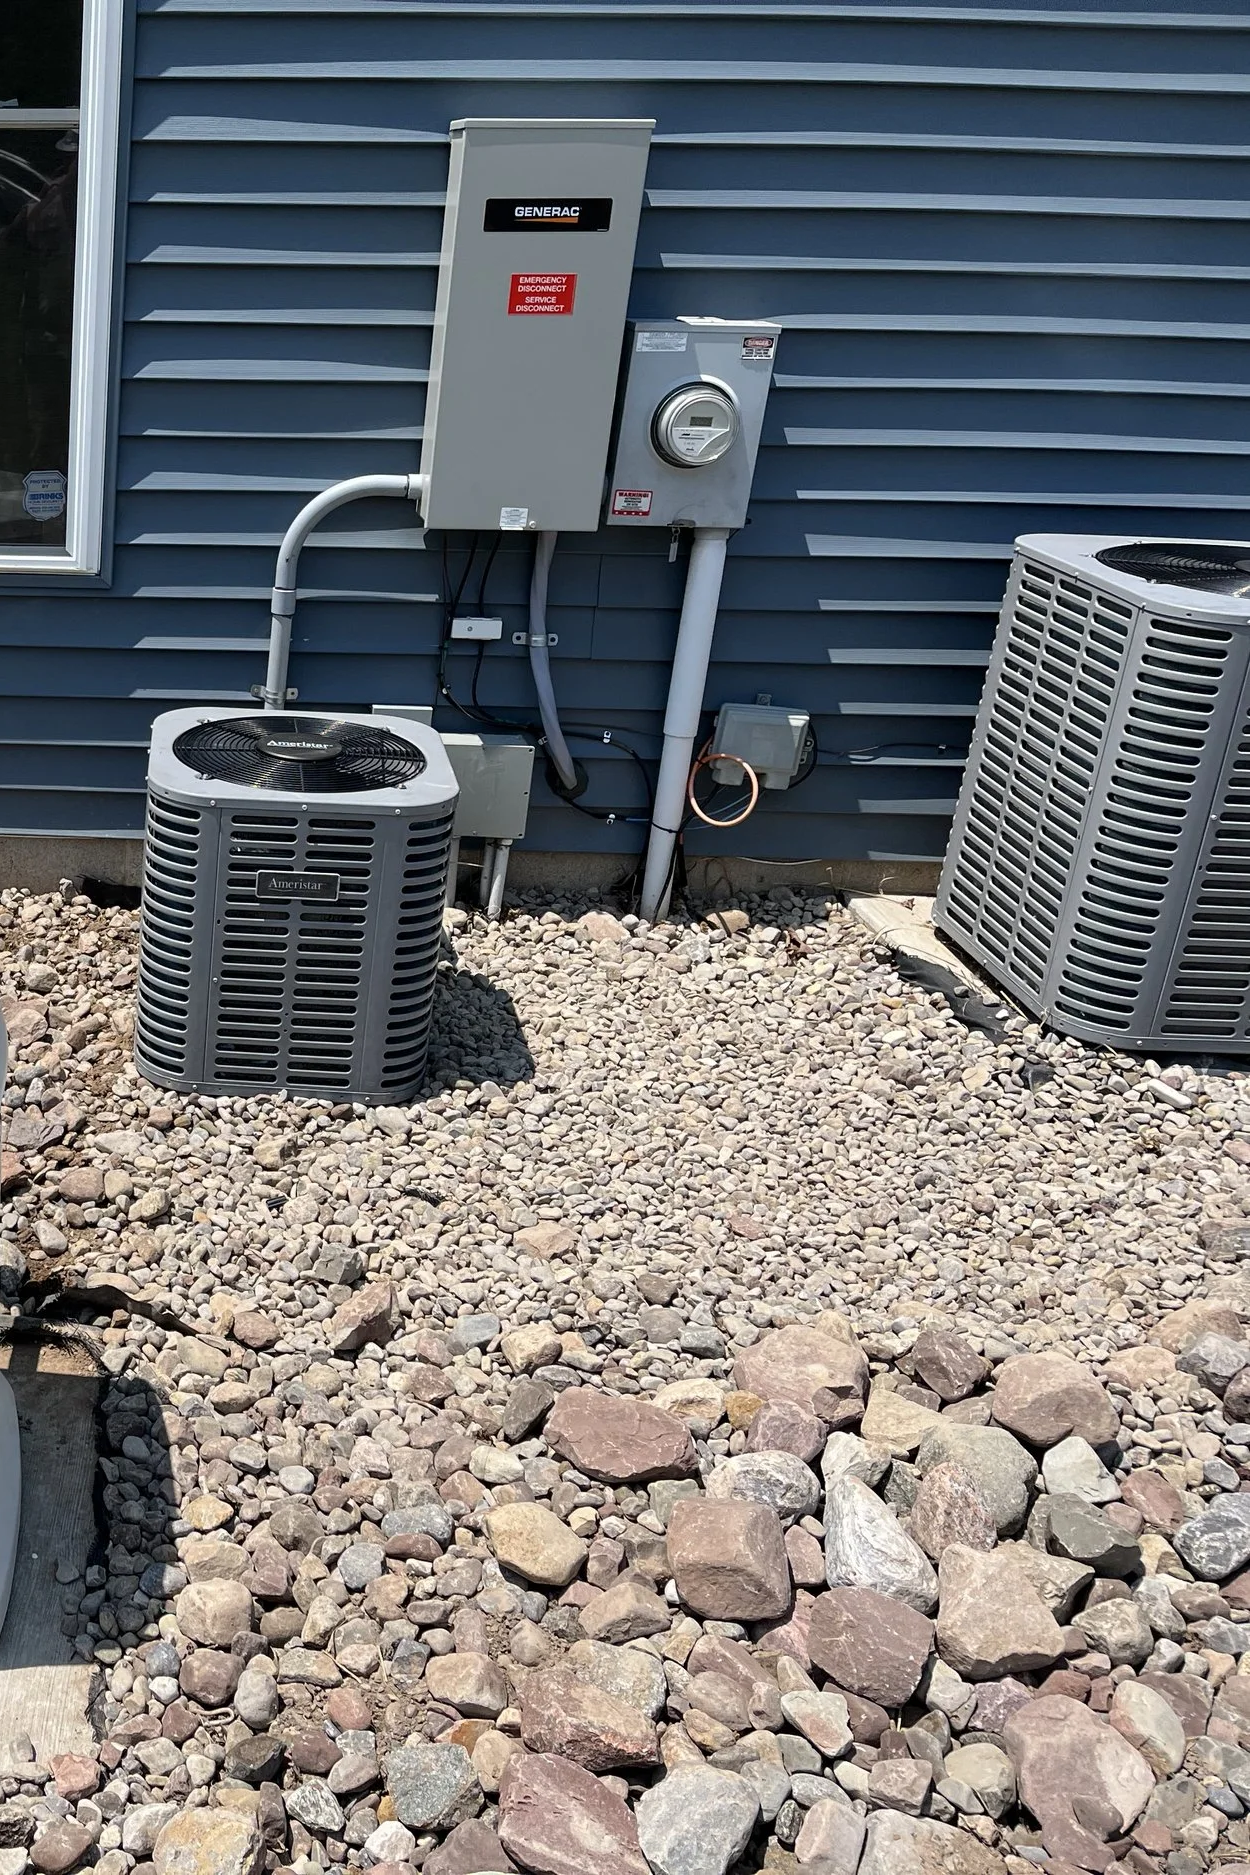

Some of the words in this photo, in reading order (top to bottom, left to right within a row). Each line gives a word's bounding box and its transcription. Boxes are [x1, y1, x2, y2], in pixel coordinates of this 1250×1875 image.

[514, 206, 580, 217] GENERAC
[519, 276, 567, 284] EMERGENCY
[525, 296, 557, 304] SERVICE
[515, 304, 565, 312] DISCONNECT
[266, 740, 329, 749] Ameristar
[268, 877, 323, 890] Ameristar
